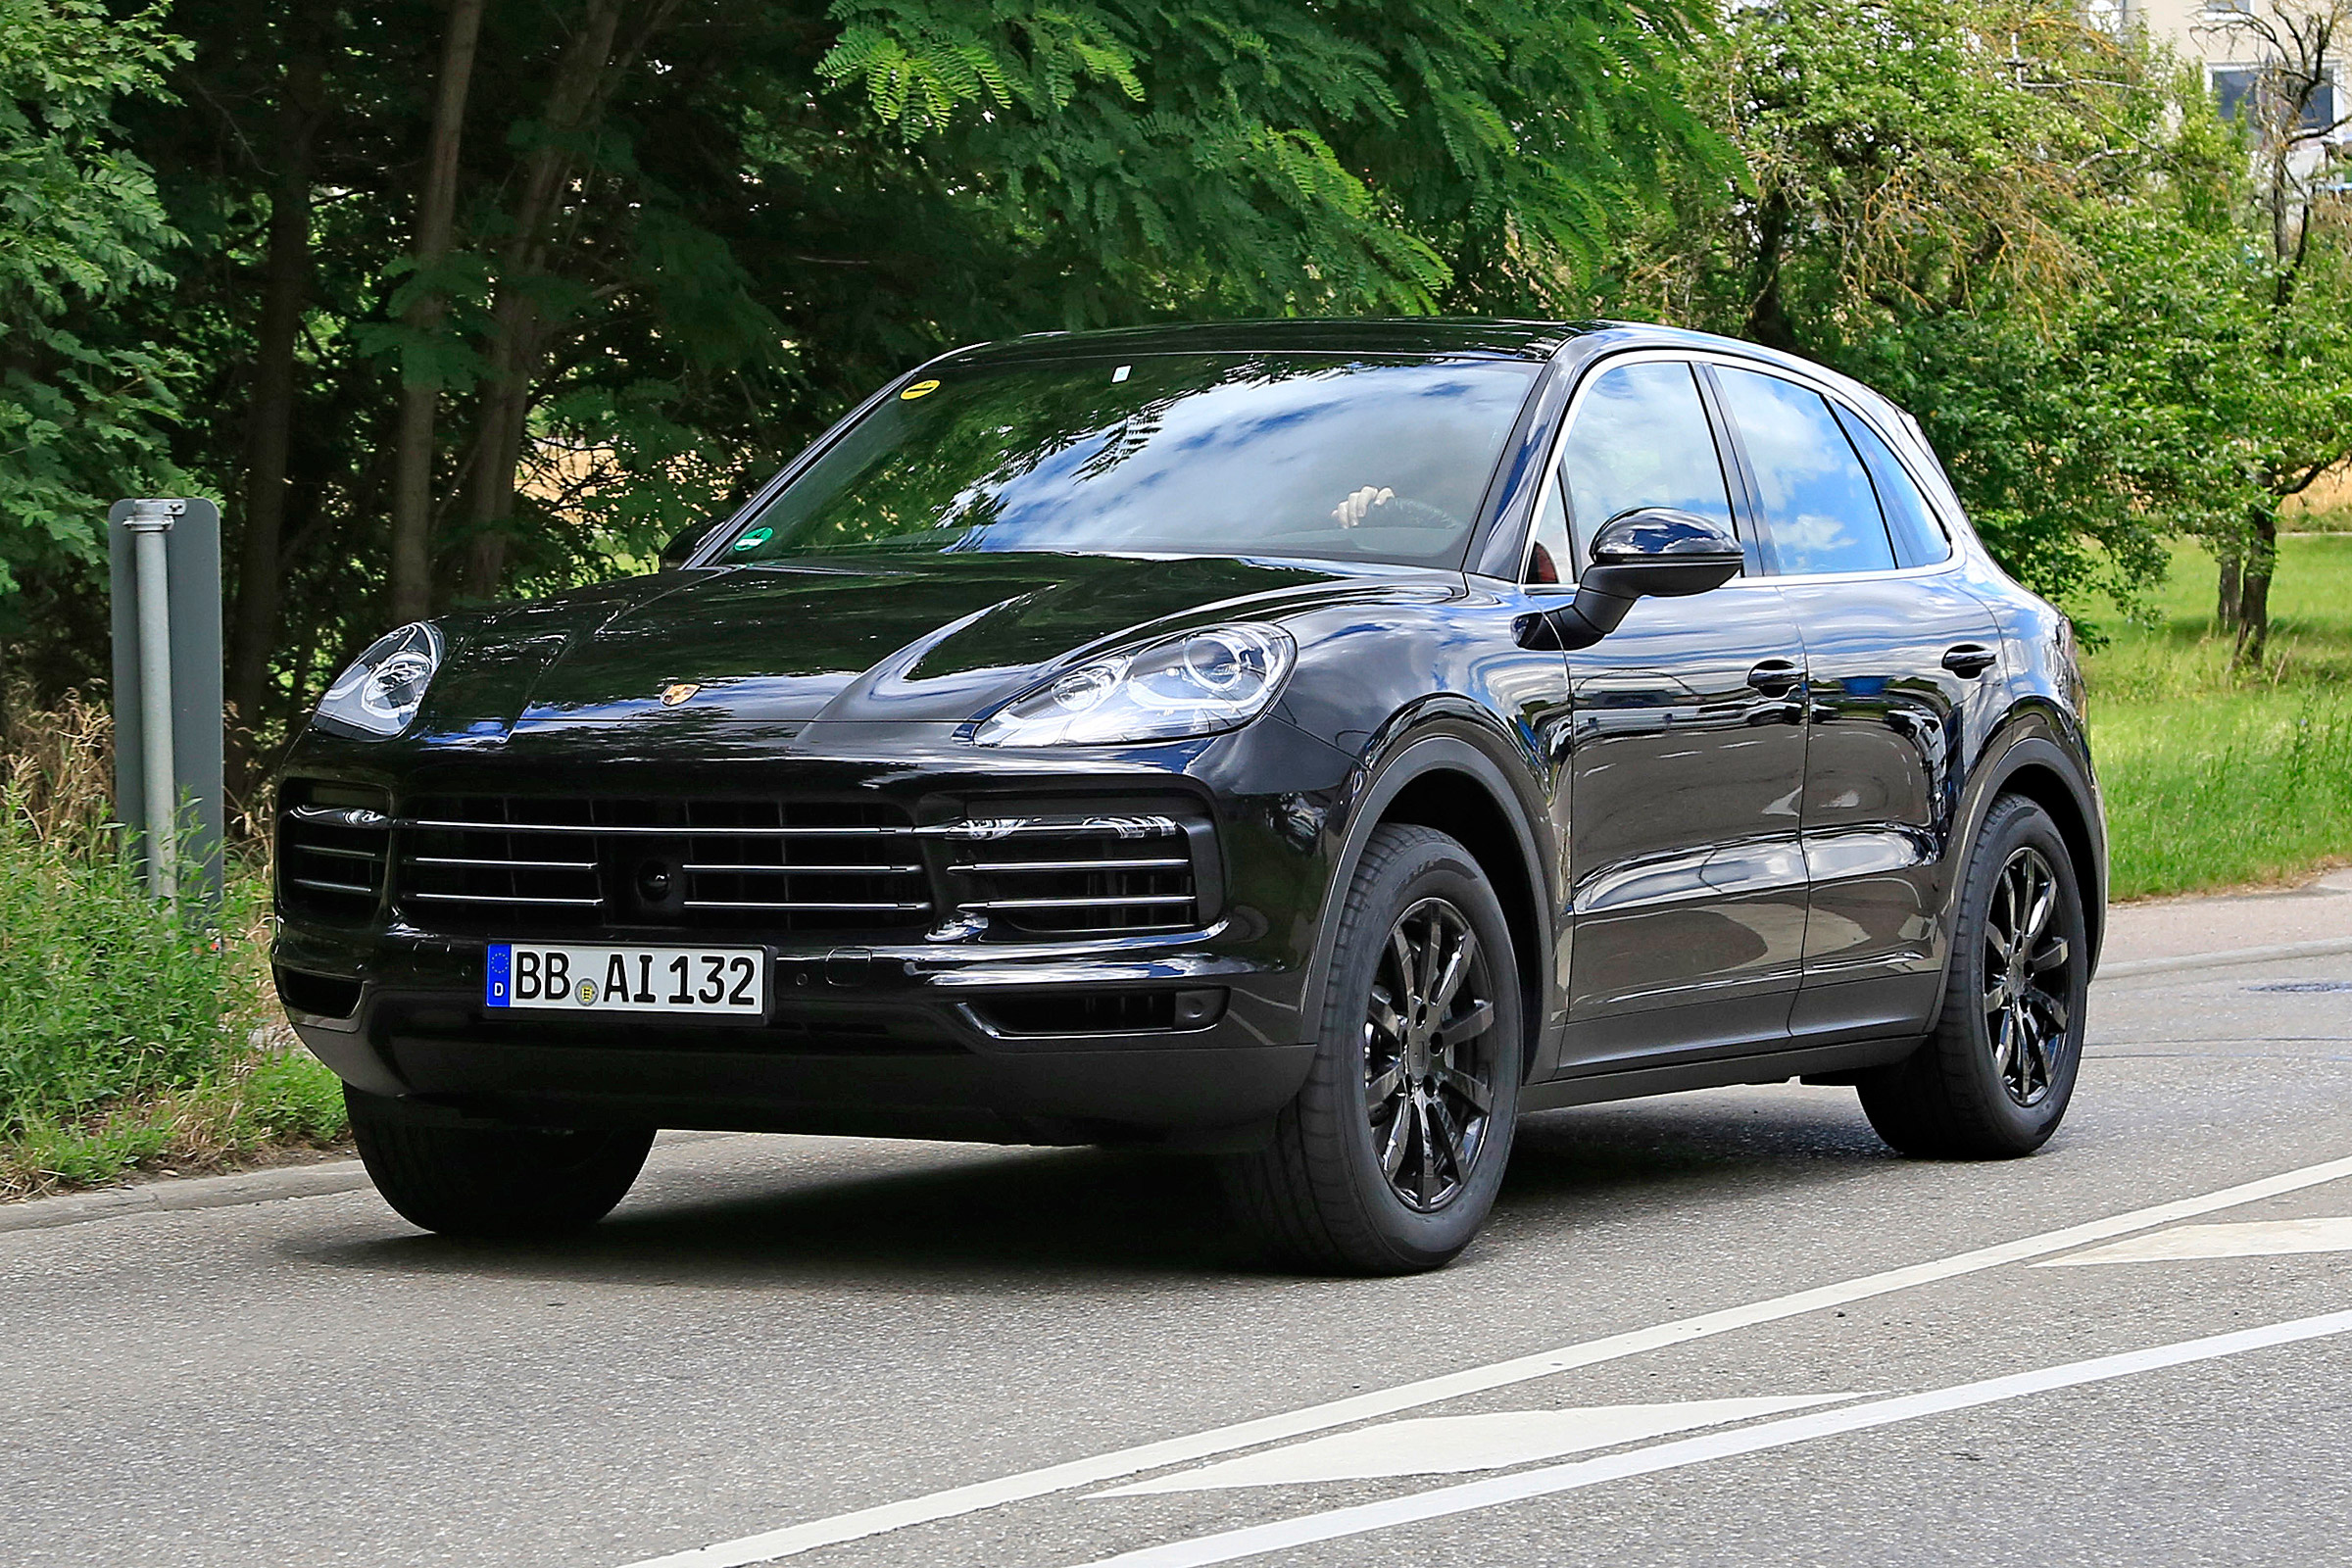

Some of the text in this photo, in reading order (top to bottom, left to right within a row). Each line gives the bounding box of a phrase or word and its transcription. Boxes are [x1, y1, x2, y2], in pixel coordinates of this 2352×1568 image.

[494, 982, 504, 997] D
[515, 951, 755, 1005] BB AI 132
